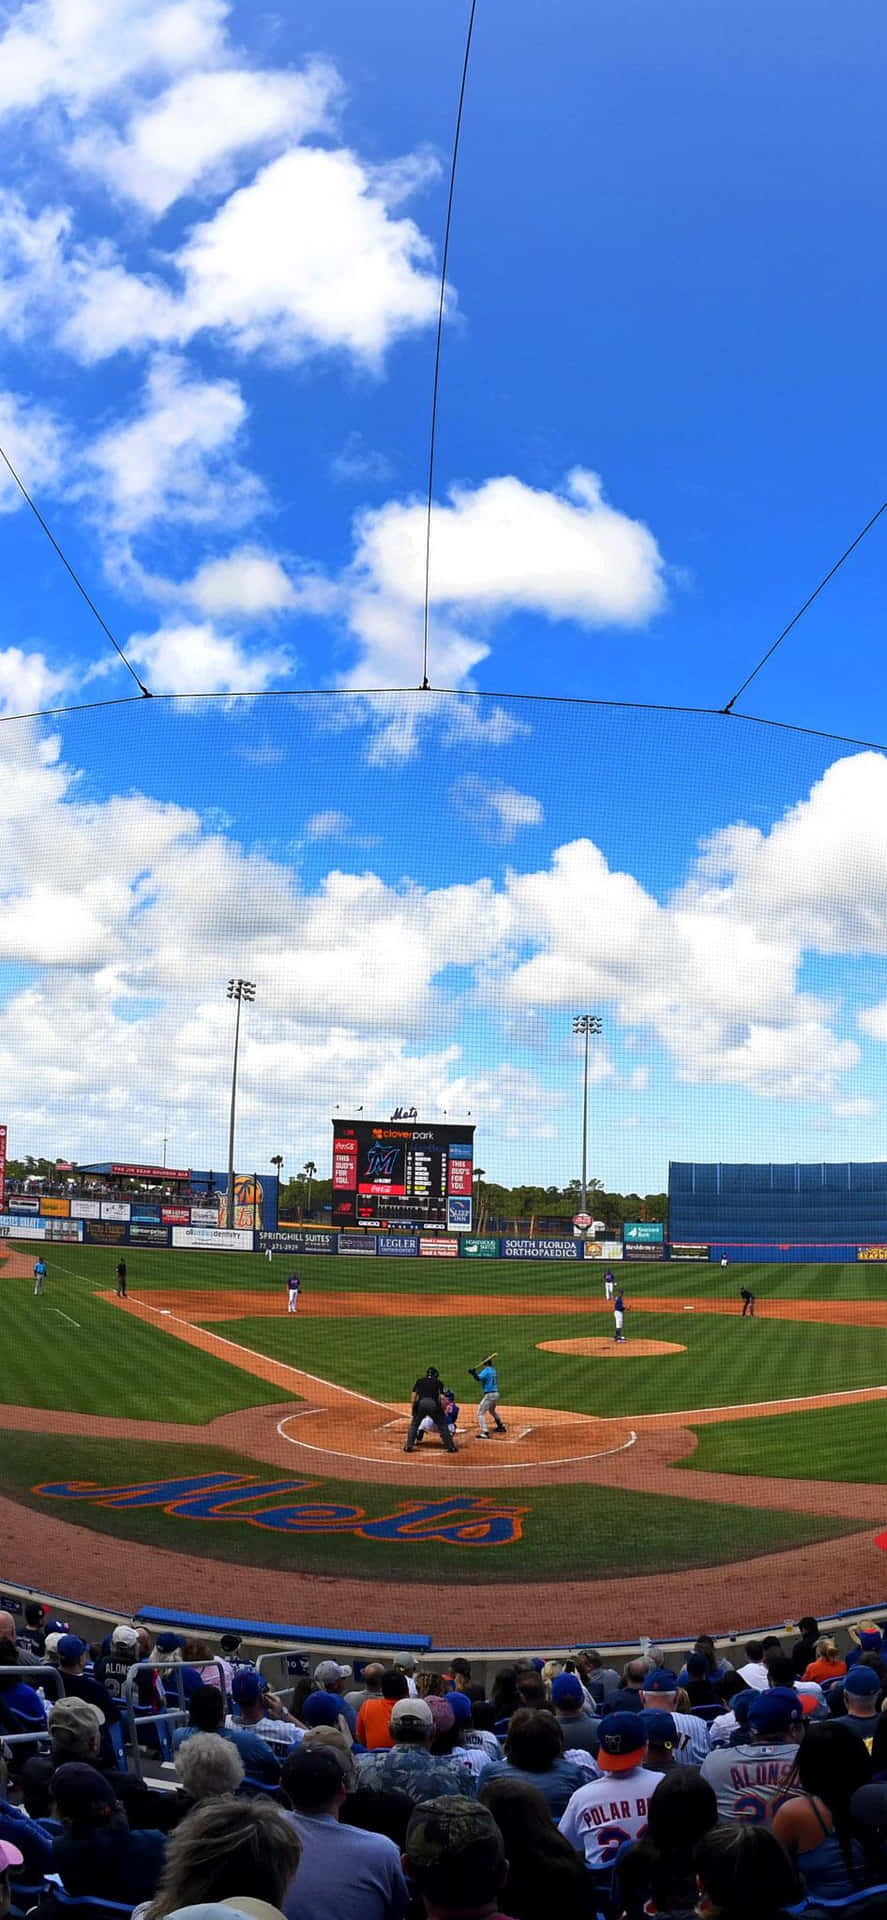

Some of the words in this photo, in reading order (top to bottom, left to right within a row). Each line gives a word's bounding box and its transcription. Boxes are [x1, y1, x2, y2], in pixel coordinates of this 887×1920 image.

[259, 1231, 304, 1242] SPRINGHILL
[305, 1233, 330, 1243] SUITES
[380, 1238, 416, 1249] LEGLER
[505, 1240, 536, 1249] SOUTH
[539, 1240, 577, 1249] FLORIDA
[505, 1248, 577, 1257] ORTHOPAEDICS
[31, 1471, 532, 1545] Mets
[584, 1801, 632, 1828] POLAR
